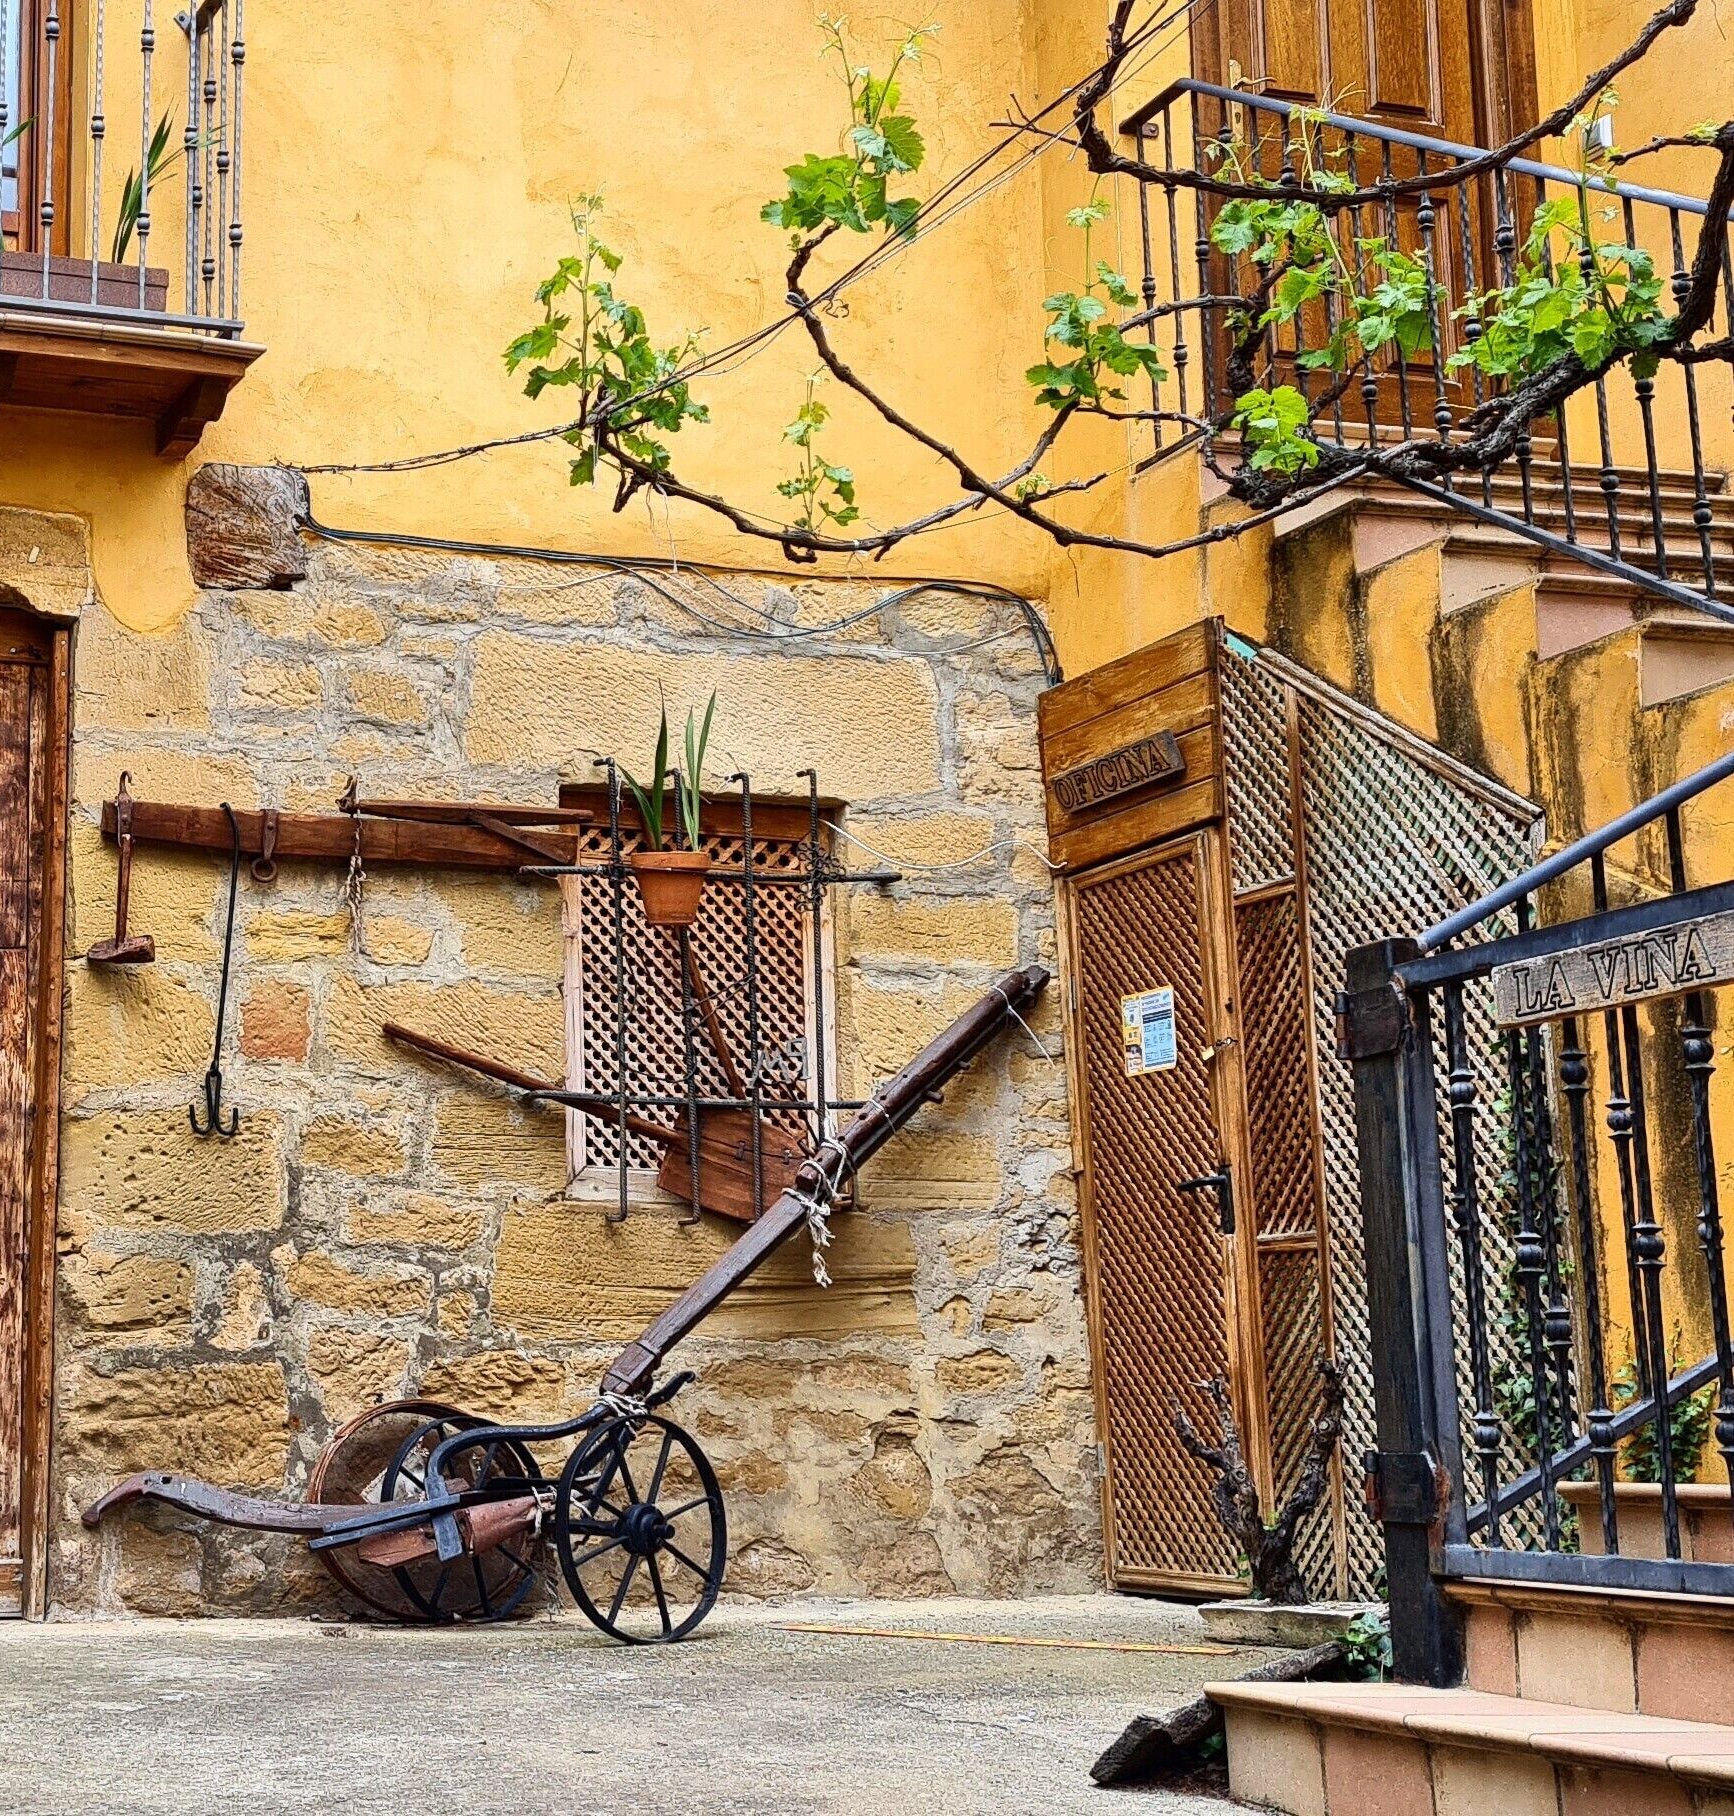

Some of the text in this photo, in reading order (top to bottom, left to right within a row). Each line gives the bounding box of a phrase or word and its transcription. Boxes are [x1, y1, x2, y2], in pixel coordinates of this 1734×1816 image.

[1054, 740, 1171, 808] OFICINA
[1513, 927, 1717, 1018] LA VIÑA
